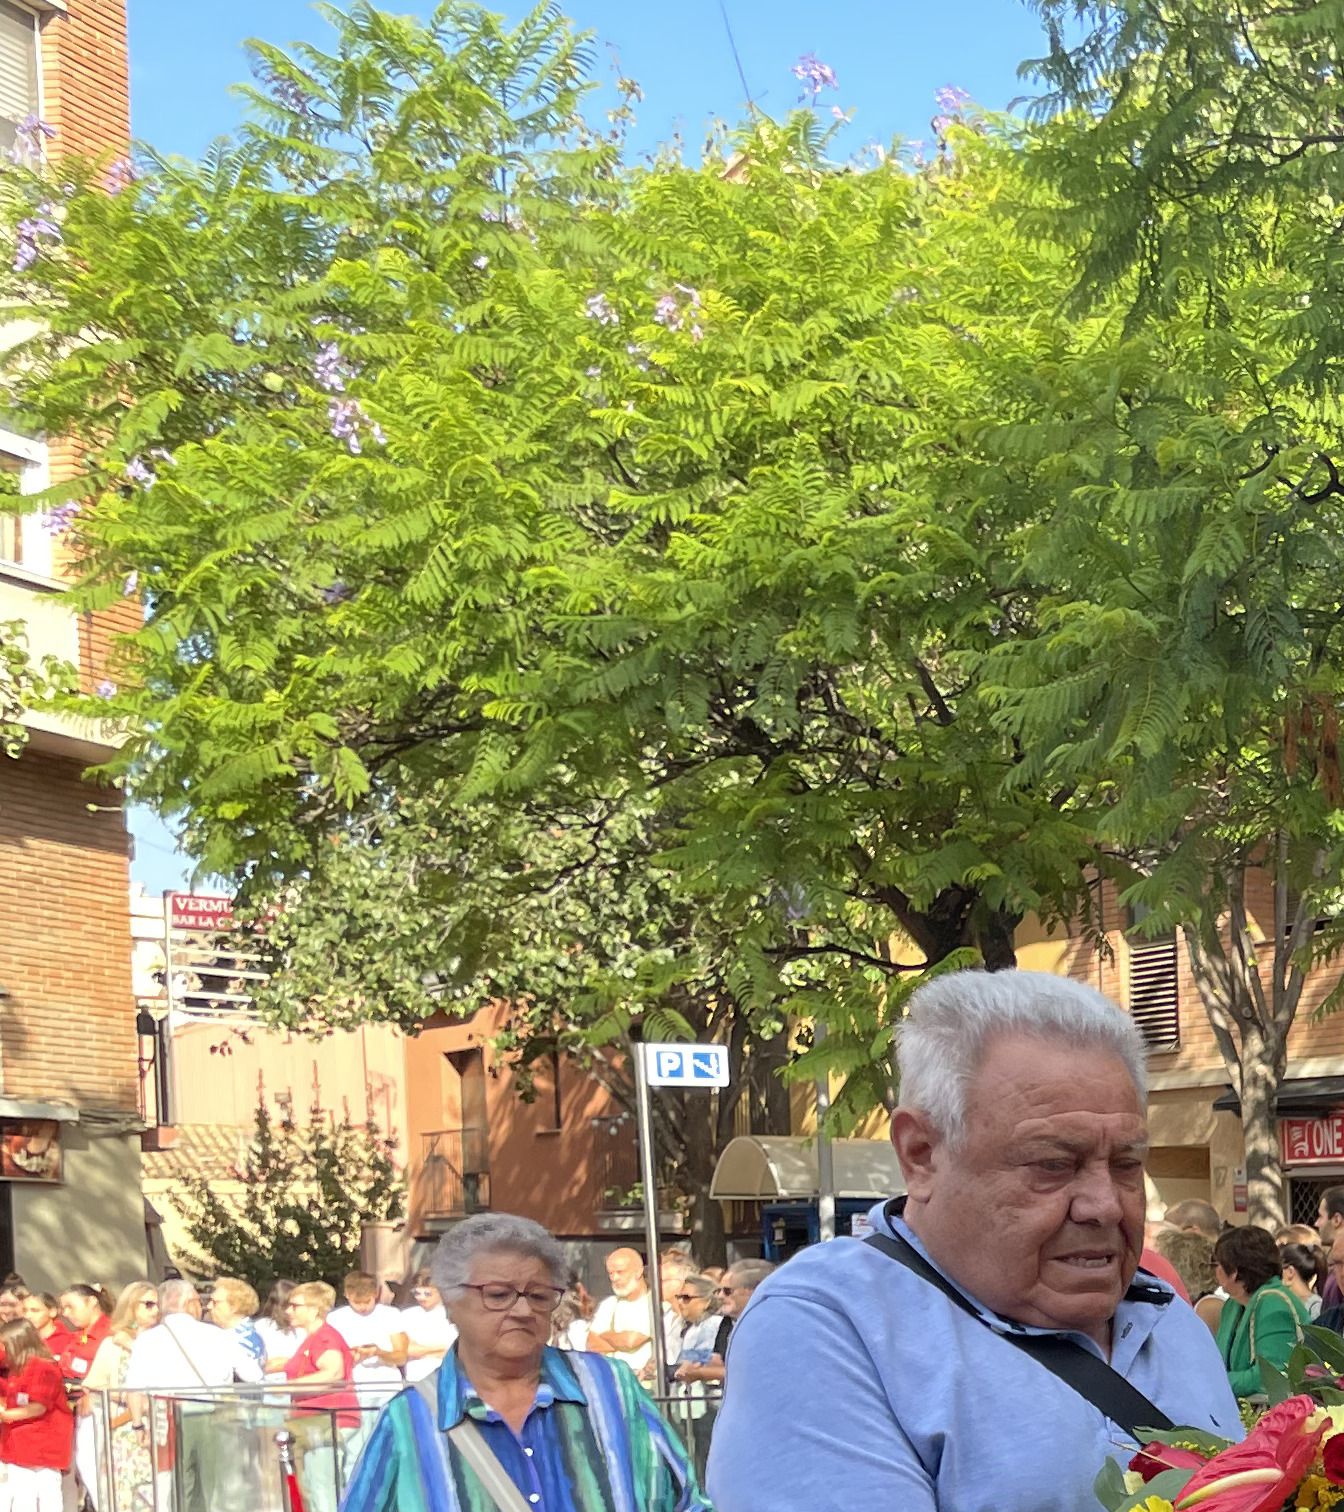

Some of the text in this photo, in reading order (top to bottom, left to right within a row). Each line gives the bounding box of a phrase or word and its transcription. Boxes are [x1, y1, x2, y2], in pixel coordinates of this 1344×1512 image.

[174, 896, 235, 914] VERMU
[659, 1052, 681, 1078] P
[1312, 1118, 1343, 1156] ONE
